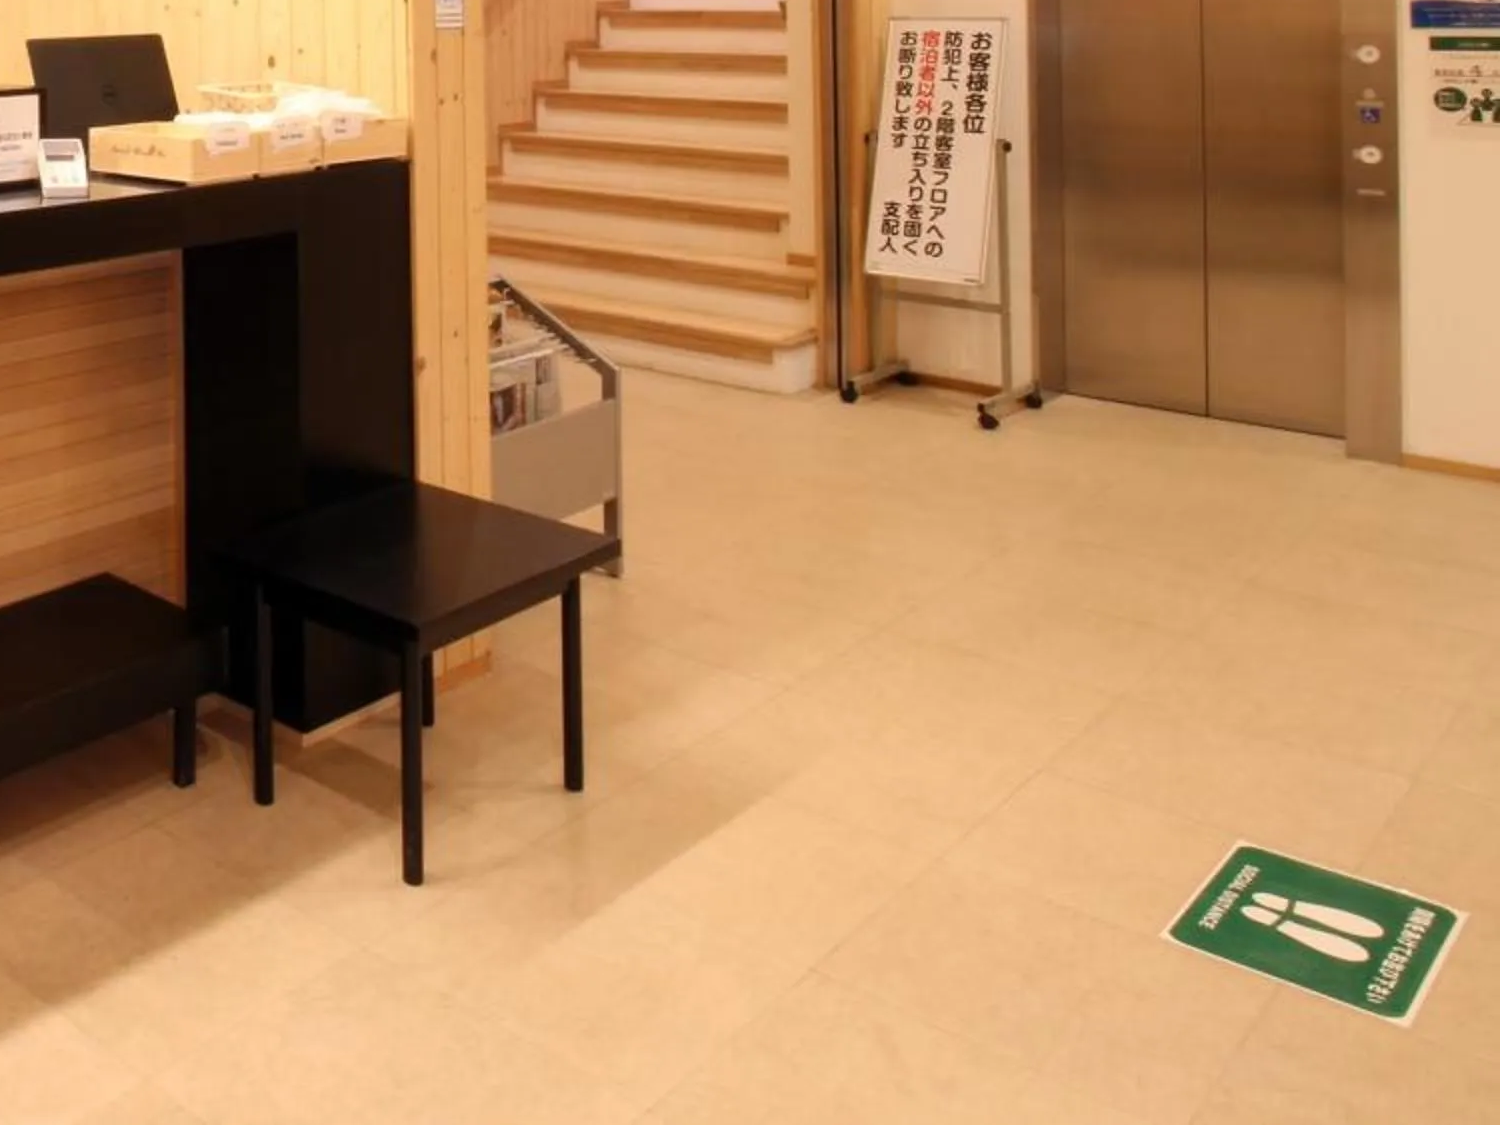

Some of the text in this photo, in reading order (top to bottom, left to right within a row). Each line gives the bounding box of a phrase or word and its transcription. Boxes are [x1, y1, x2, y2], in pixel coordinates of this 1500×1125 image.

[891, 31, 918, 149] お断り致します
[963, 32, 992, 135] お客様各位
[903, 31, 940, 257] 宿泊者以外の立ち入りを固く
[879, 201, 900, 255] 支配人
